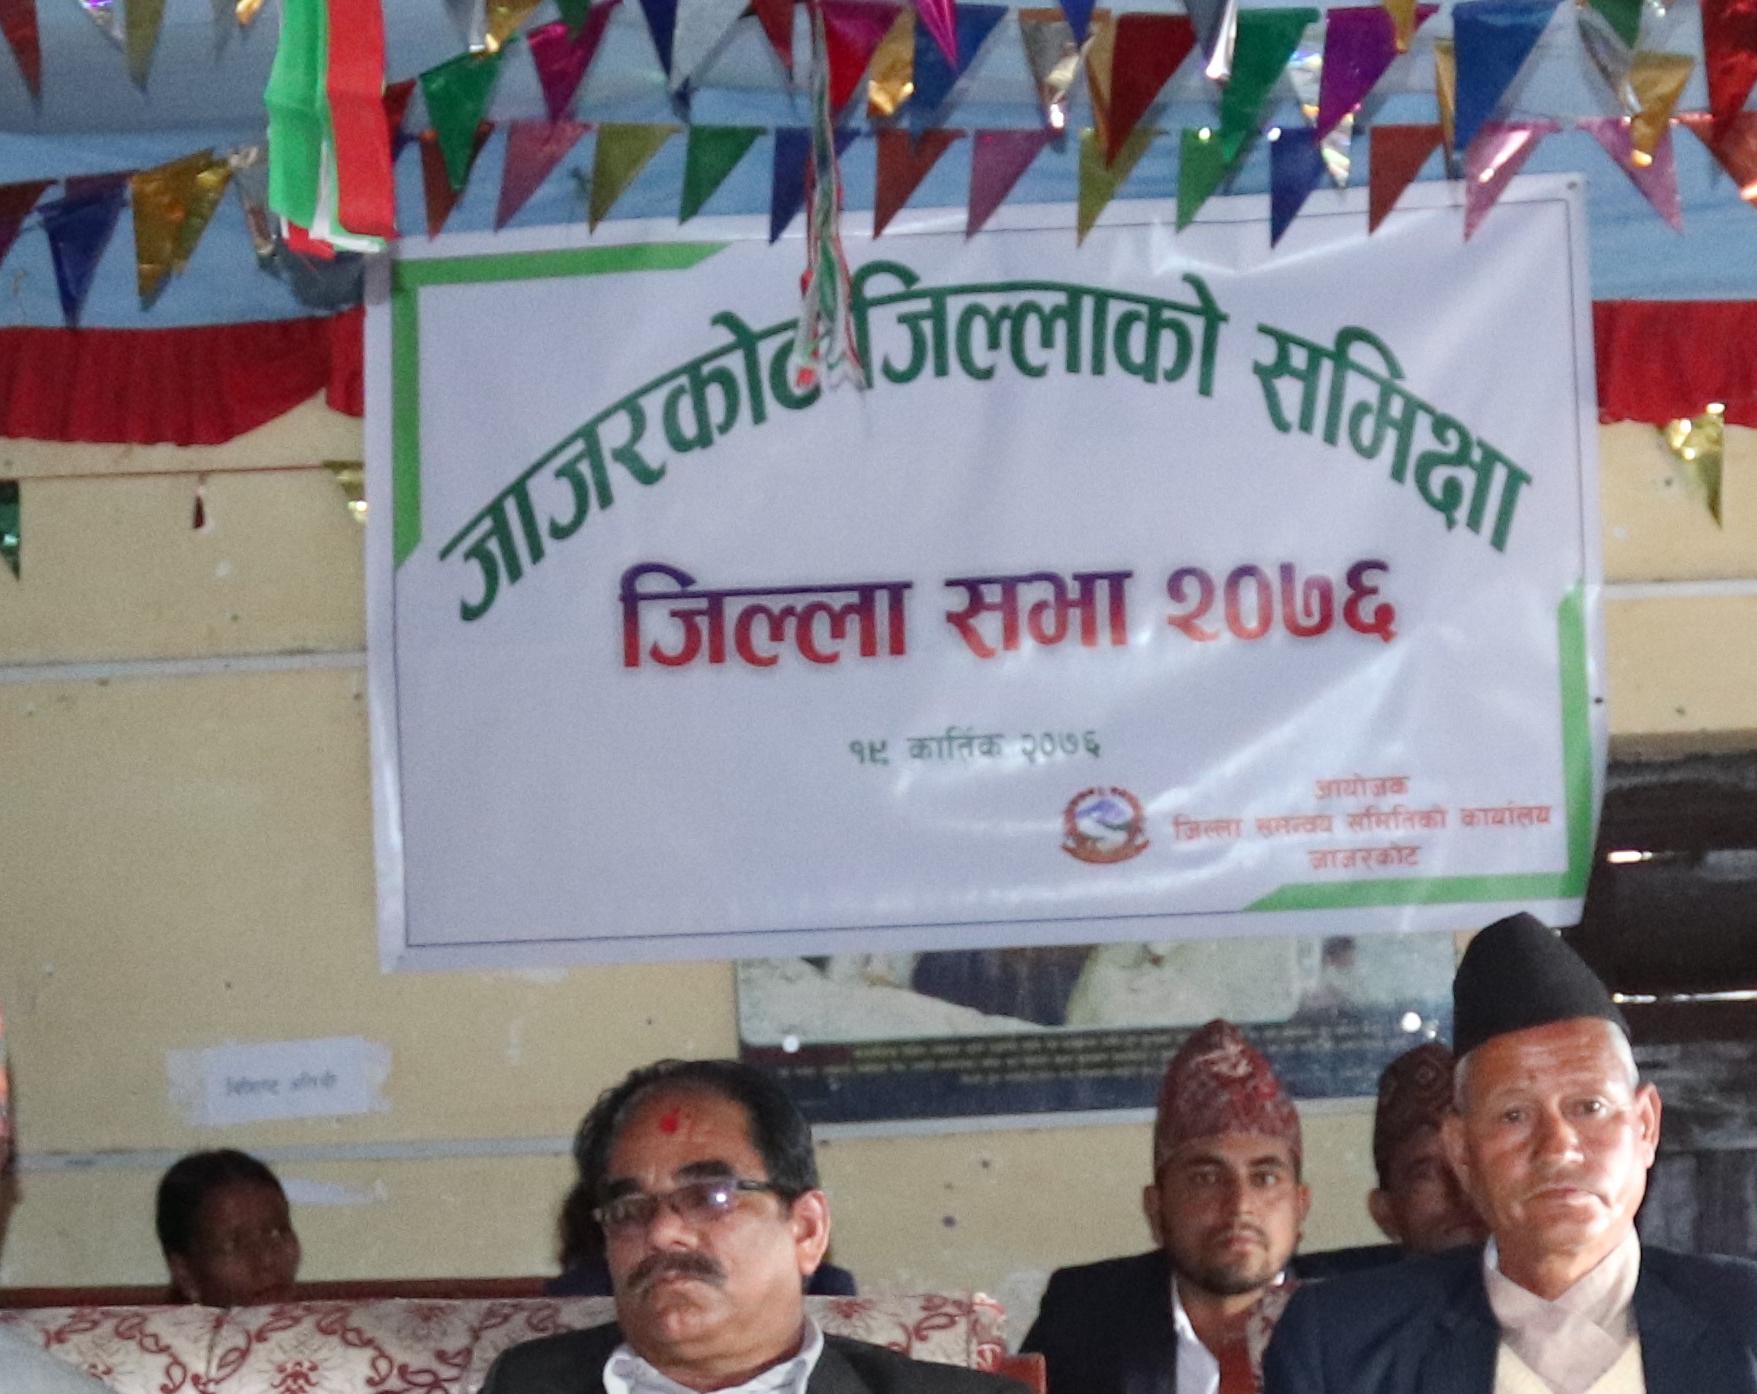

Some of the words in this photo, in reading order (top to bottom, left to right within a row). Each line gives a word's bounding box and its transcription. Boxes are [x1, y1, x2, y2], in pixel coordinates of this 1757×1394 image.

[851, 259, 1229, 398] जिल्लाको
[1251, 324, 1533, 554] समिक्षा
[617, 561, 914, 669] जिल्ला
[943, 568, 1135, 660] सभा
[1165, 558, 1399, 645] २०७६
[1020, 729, 1102, 764] २०७६
[1172, 813, 1245, 842] जिल्ला
